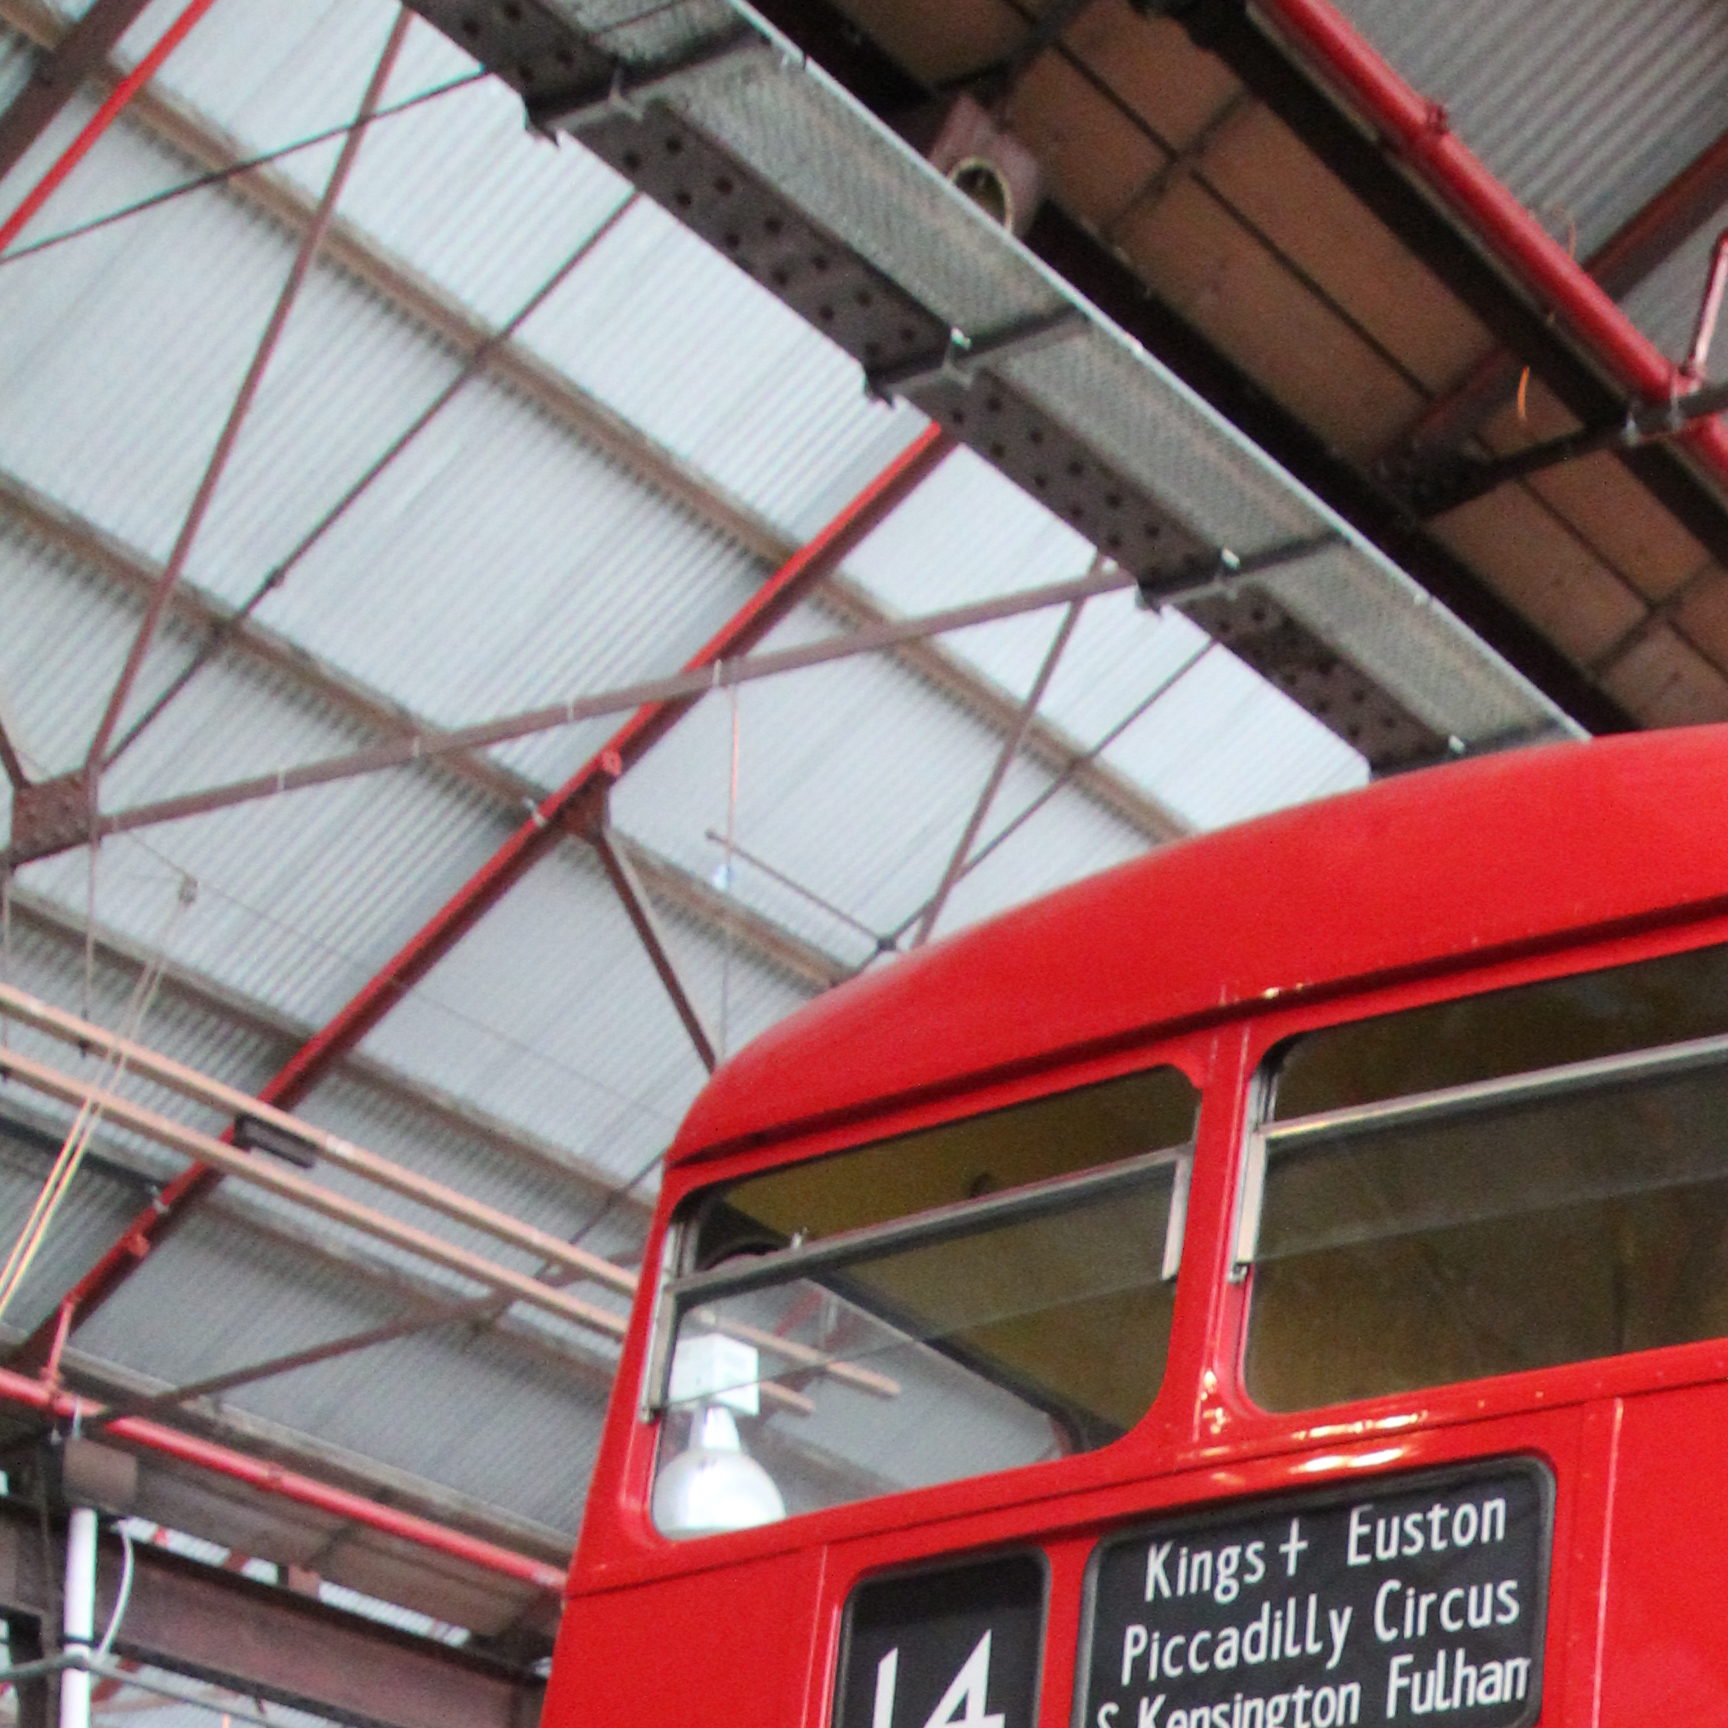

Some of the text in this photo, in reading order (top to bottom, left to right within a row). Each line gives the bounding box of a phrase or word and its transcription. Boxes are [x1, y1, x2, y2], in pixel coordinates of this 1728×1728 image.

[1144, 1540, 1266, 1603] Kings
[1347, 1498, 1507, 1567] Euston
[1121, 1579, 1520, 1686] Piccadilly Circus
